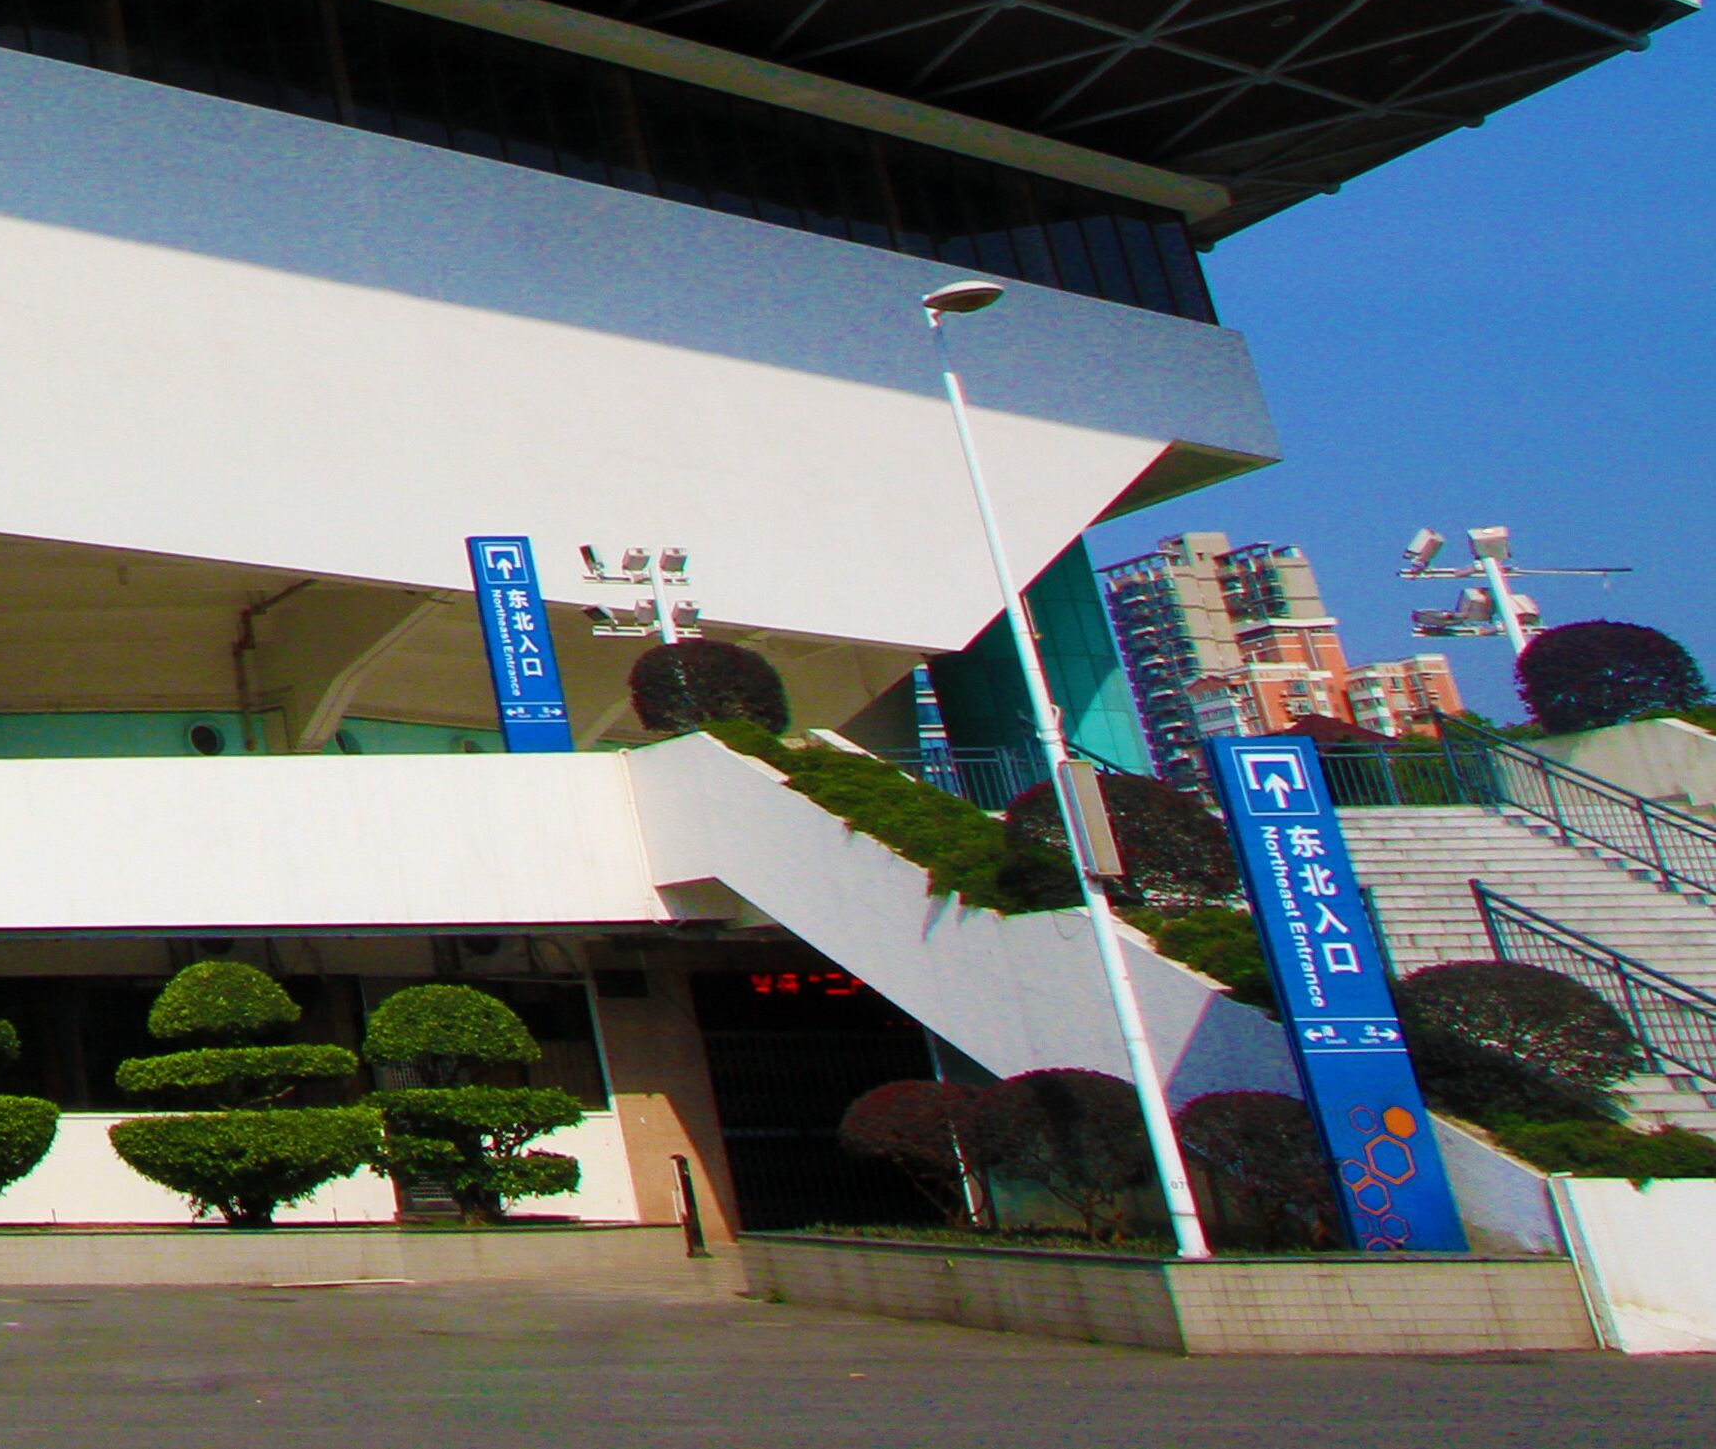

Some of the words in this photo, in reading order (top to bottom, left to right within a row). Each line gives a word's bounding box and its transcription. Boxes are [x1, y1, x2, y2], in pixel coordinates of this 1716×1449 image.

[491, 589, 512, 644] Northeast
[503, 645, 521, 697] Entrance
[506, 589, 543, 677] 东北入口
[1259, 825, 1304, 919] Northeast
[1287, 921, 1328, 1009] Entrance
[1285, 825, 1363, 974] 东北入口
